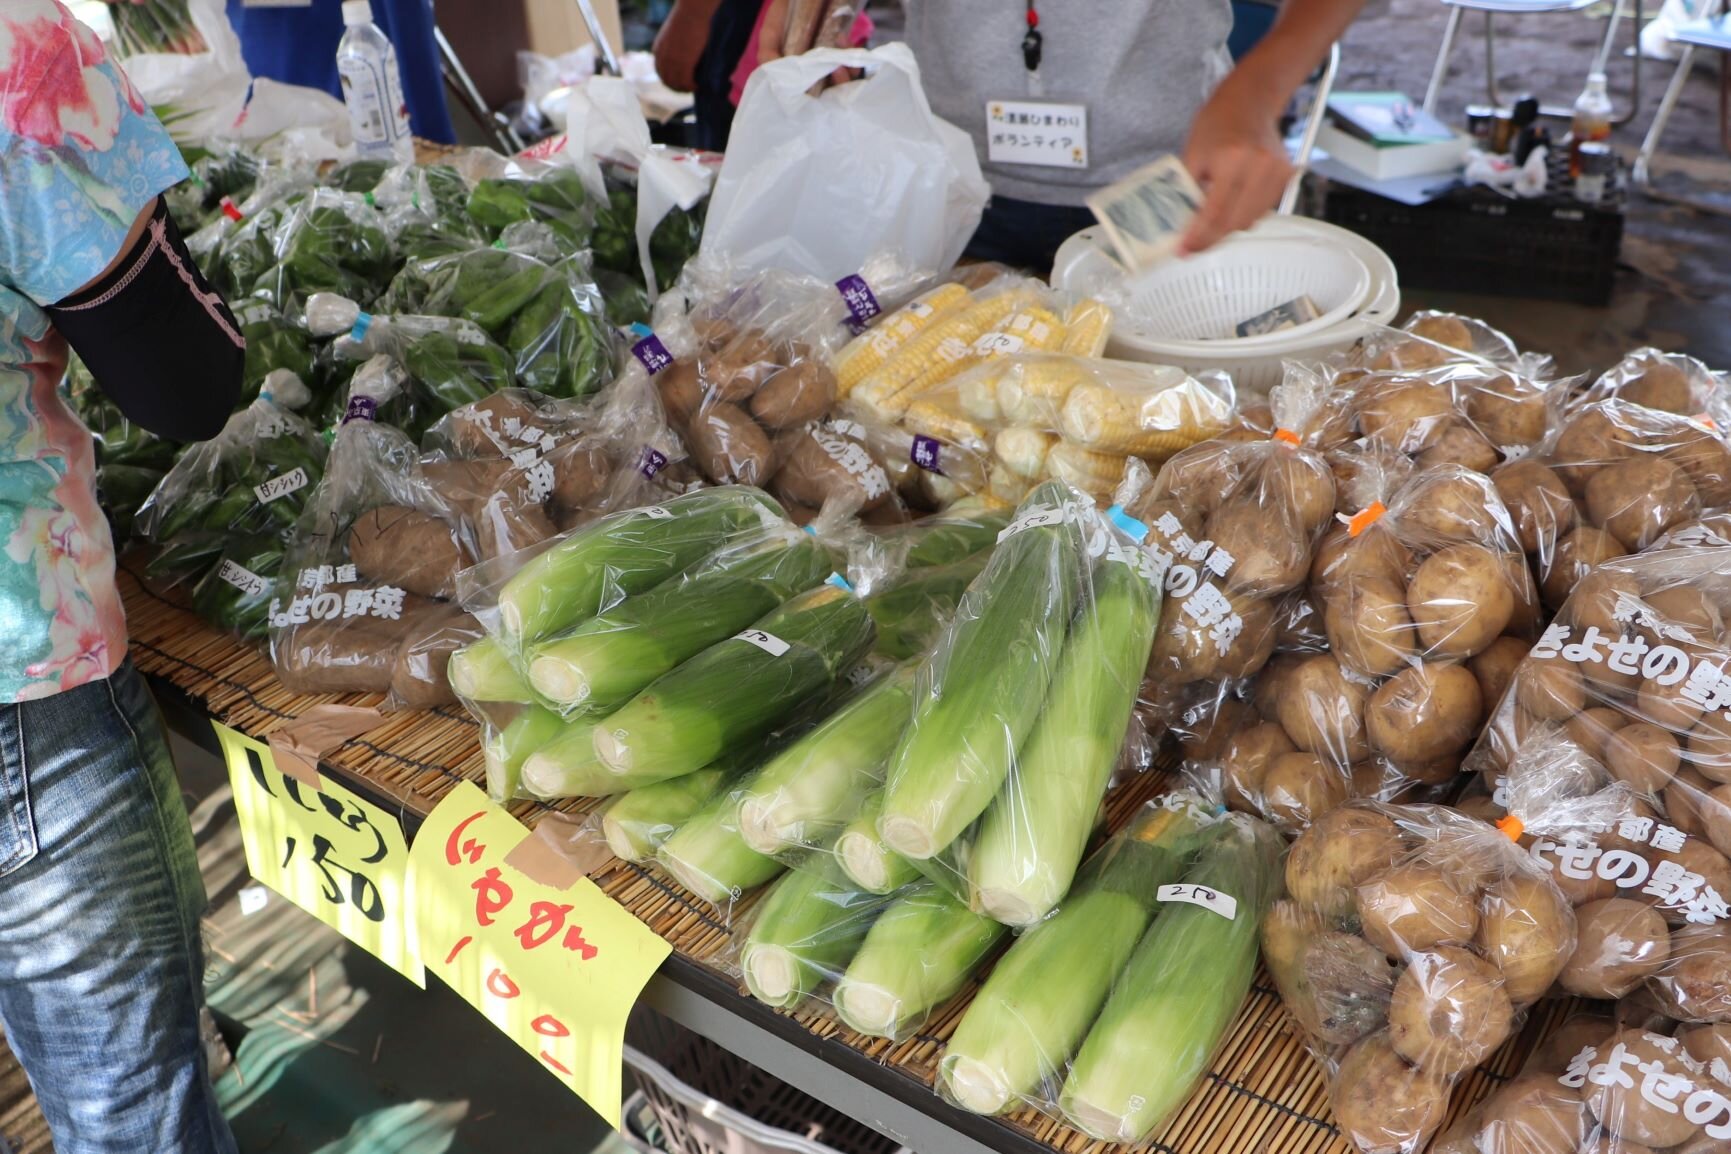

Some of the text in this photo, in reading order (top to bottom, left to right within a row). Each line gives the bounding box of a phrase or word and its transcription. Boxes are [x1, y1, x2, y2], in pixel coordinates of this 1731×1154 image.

[992, 133, 1073, 149] ボランティア
[281, 834, 387, 923] 150
